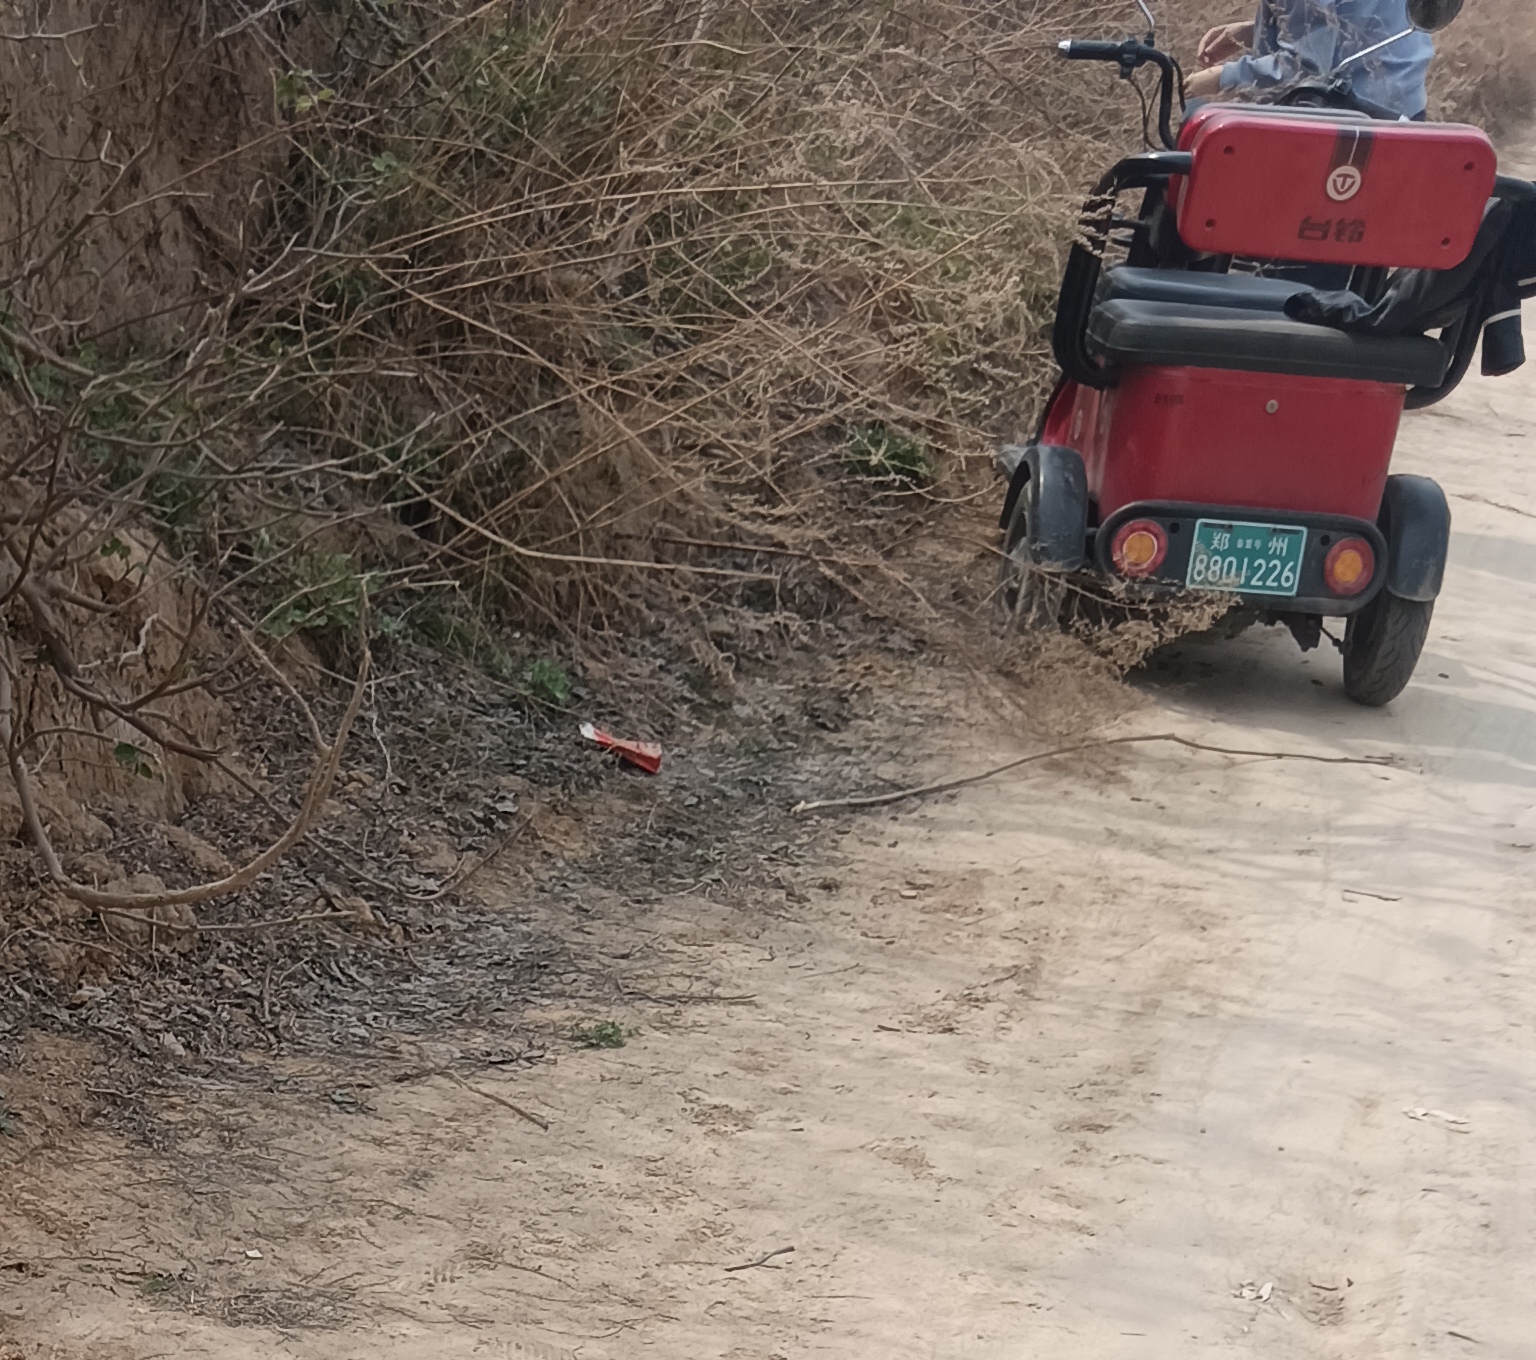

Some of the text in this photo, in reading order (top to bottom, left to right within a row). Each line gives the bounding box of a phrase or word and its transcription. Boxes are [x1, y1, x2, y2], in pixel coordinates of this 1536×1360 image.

[1210, 531, 1230, 552] 郑
[1268, 536, 1289, 557] 州
[1193, 554, 1295, 588] 8801226
